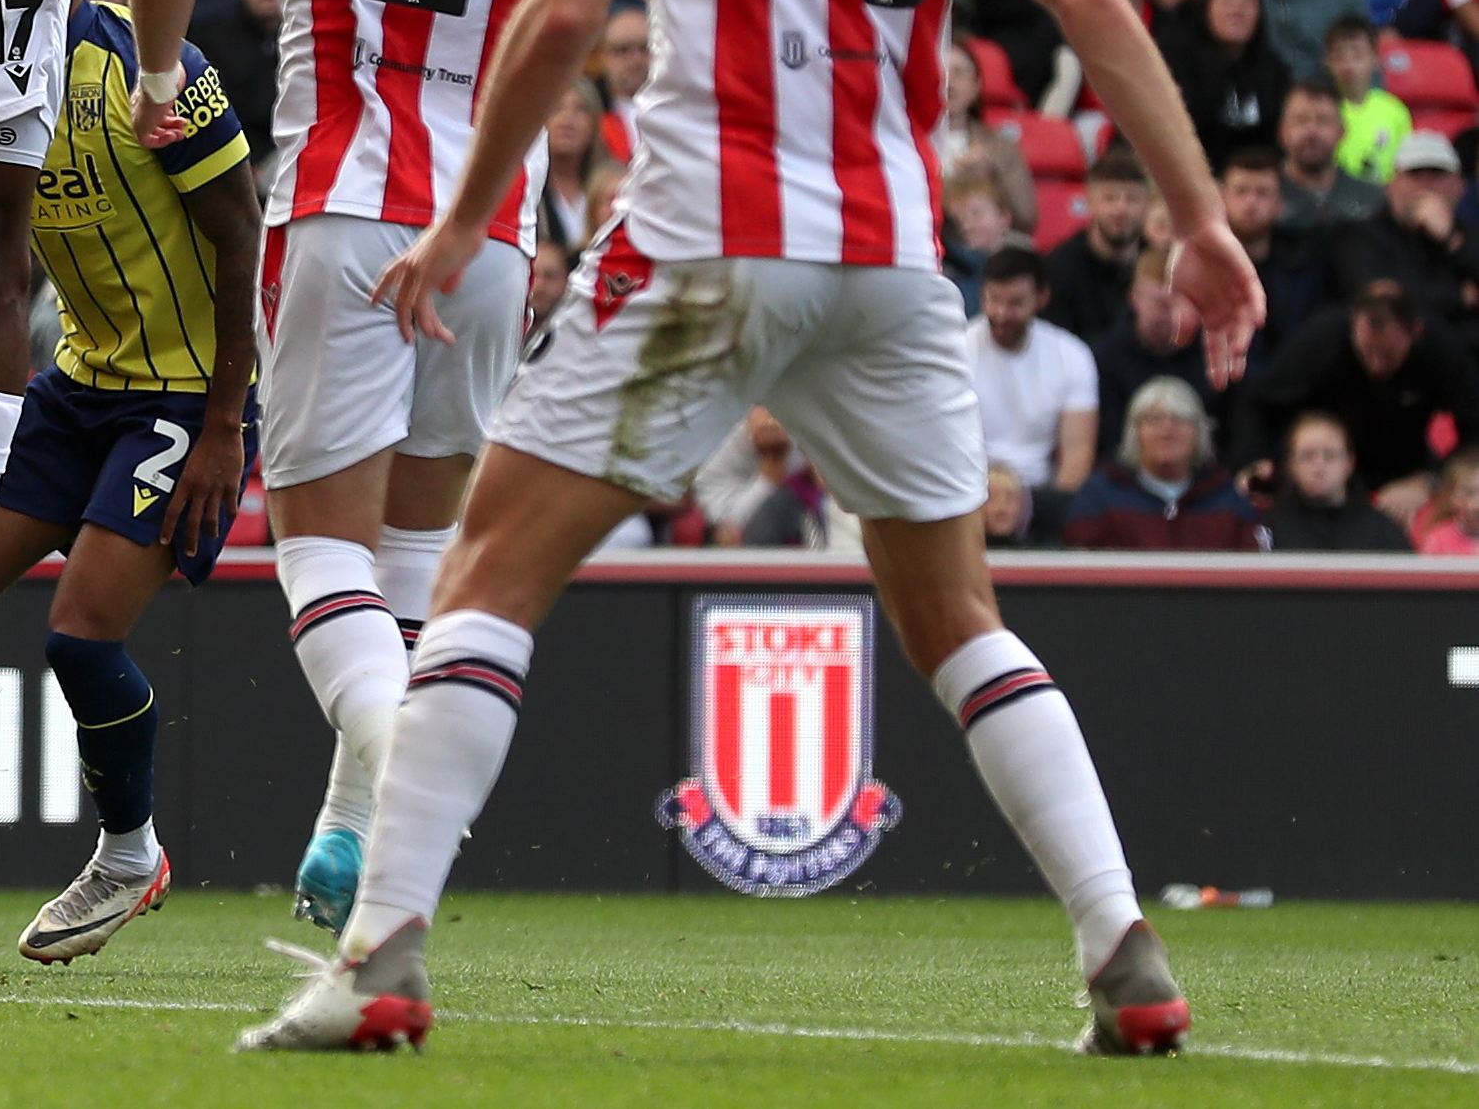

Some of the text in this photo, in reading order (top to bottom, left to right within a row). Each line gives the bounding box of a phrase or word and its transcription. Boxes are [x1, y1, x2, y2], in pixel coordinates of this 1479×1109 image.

[438, 68, 473, 86] Trust
[184, 87, 229, 138] BOSS
[36, 154, 104, 200] eal
[31, 198, 112, 220] ATING
[133, 418, 190, 493] 2
[712, 624, 850, 653] STOKE
